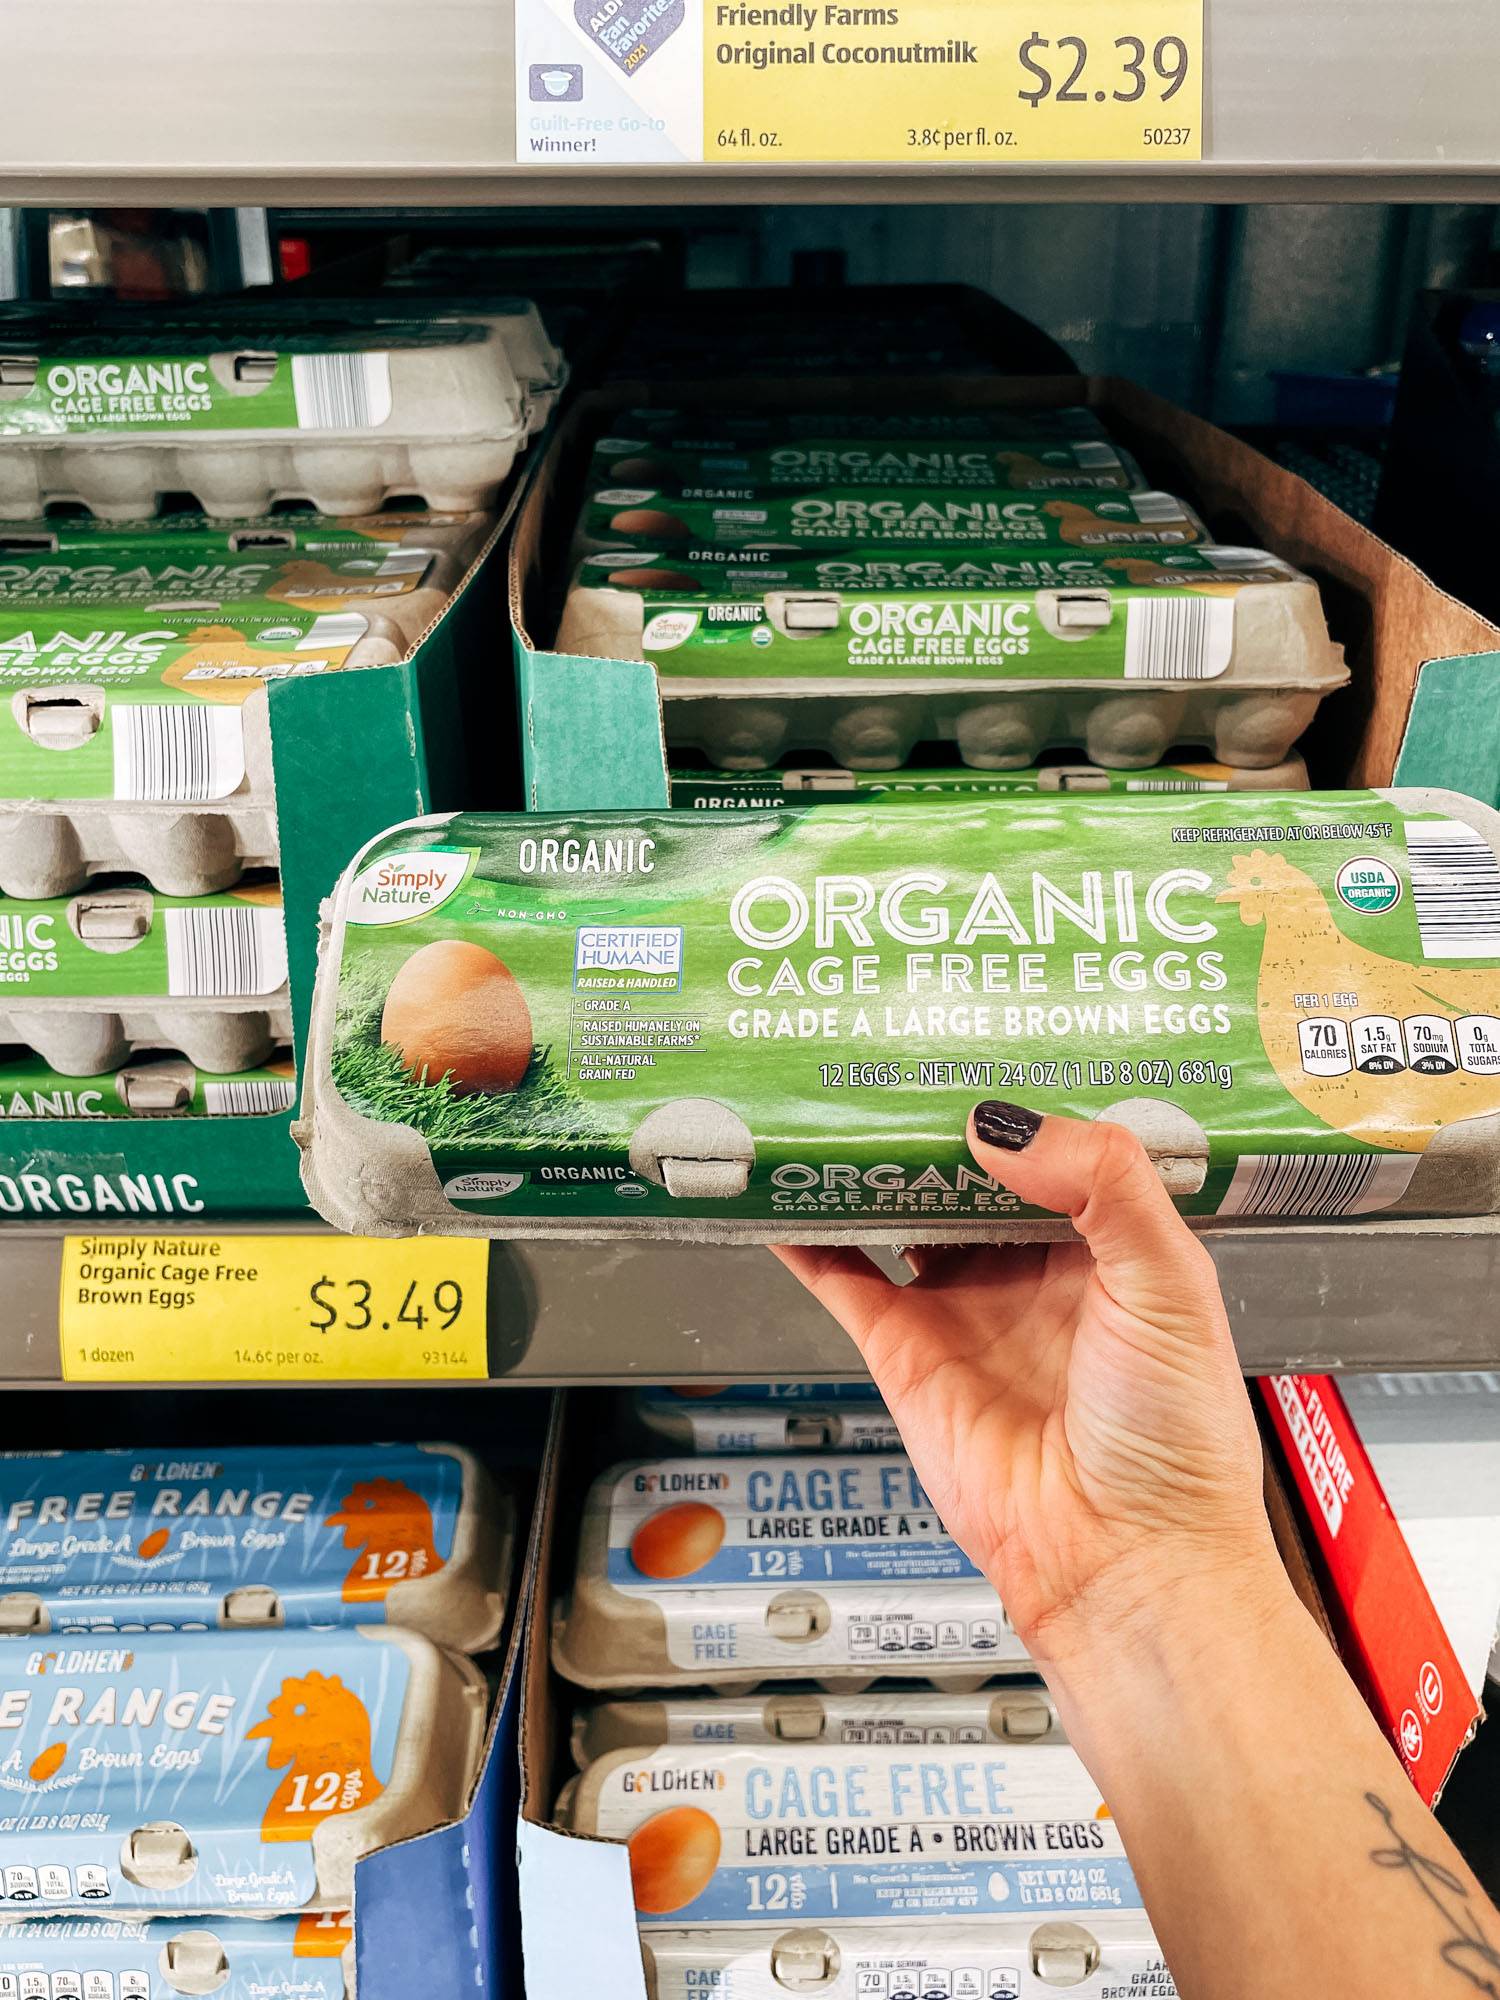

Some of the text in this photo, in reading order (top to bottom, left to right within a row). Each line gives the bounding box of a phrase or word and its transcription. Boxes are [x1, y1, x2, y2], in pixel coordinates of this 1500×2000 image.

[716, 3, 899, 31] Friendly Farms
[598, 16, 631, 46] Fan
[623, 44, 649, 70] 2021
[716, 40, 977, 69] Original Coconutmilk
[1017, 32, 1188, 108] $2.39
[529, 115, 666, 132] Guilt-Free Go-to
[530, 137, 596, 152] Winner!
[717, 128, 783, 147] 64 fl. oz.
[907, 128, 1017, 150] 3.8¢ per fl. oz.
[1142, 128, 1191, 146] 50237
[47, 362, 209, 397] ORGANIC
[50, 394, 213, 414] CAGE FREE EGGS
[790, 500, 1039, 522] ORGANIC
[688, 551, 771, 563] ORGANIC
[707, 606, 763, 622] ORGANIC
[849, 602, 1031, 637] ORGANIC
[847, 637, 1030, 655] CAGE FREE EGGS
[847, 656, 1004, 666] GRADE A LARGE BROWN EGGS
[1172, 822, 1393, 843] KEEP REFRIGERATED AT OR BELOW 45°F
[518, 838, 656, 875] ORGANIC
[377, 868, 447, 891] Simply
[1350, 871, 1386, 885] USDA
[362, 887, 431, 905] Nature
[1347, 887, 1392, 900] ORGANIC
[497, 908, 568, 920] NON-GMO
[729, 868, 1219, 951] ORGANIC
[580, 933, 678, 948] CERTIFIED
[581, 951, 675, 966] HUMANE
[577, 978, 677, 988] RAISED & HANDLED
[727, 950, 1228, 997] CAGE FREE EGGS
[583, 1000, 631, 1011] GRADE A
[1294, 992, 1359, 1008] PER 1 EGG
[583, 1020, 700, 1032] RAISED HUMANELY ON
[727, 1003, 1233, 1039] GRADE A LARGE BROWN EGGS
[581, 1035, 655, 1046] SUSTAINABLE
[1309, 1024, 1338, 1047] 70
[1364, 1026, 1391, 1042] 1.5g
[1413, 1026, 1445, 1043] 70mg
[1473, 1026, 1489, 1043] 0g
[1304, 1049, 1347, 1059] CALORIES
[1361, 1043, 1398, 1054] SAT FAT
[1413, 1042, 1449, 1053] SODIUM
[1469, 1043, 1498, 1053] TOTAL
[580, 1054, 656, 1066] ALL-NATURAL
[579, 1068, 636, 1080] GRAIN FED
[819, 1060, 1233, 1091] 12 EGGS NET WT 24 OZ (1 LB 8 OZ) 681g
[461, 1177, 511, 1188] Simply
[540, 1166, 626, 1180] ORGANIC
[770, 1163, 1006, 1191] ORGAN
[0, 1173, 205, 1214] ORGANIC
[455, 1185, 507, 1193] Nature
[770, 1191, 960, 1205] CAGE FREE
[80, 1237, 221, 1259] Simply Nature
[79, 1263, 259, 1285] Organic Cage Free
[78, 1288, 196, 1309] Brown Eggs
[309, 1275, 463, 1333] $3.49
[79, 1348, 135, 1363] 1 dozen
[234, 1350, 324, 1367] 14.6¢ per oz.
[422, 1351, 468, 1366] 93144
[1306, 1389, 1355, 1504] FUTURE
[746, 1468, 866, 1514] CAGE
[7, 1488, 314, 1533] FREE RANGE
[746, 1518, 814, 1539] LARGE
[820, 1517, 892, 1538] GRADE
[896, 1516, 911, 1537] A
[9, 1529, 288, 1559] Large Grade A Brown Eggs
[362, 1550, 409, 1580] 12
[747, 1551, 787, 1577] 12
[693, 1624, 738, 1641] CAGE
[693, 1643, 738, 1660] FREE
[47, 1686, 236, 1735] RANGE
[79, 1743, 202, 1772] Brown Eggs
[285, 1771, 342, 1812] 12
[744, 1761, 1014, 1819] CAGE FREE
[746, 1820, 1104, 1857] LARGE GRADE A BROWN EGGS
[746, 1873, 790, 1911] 12
